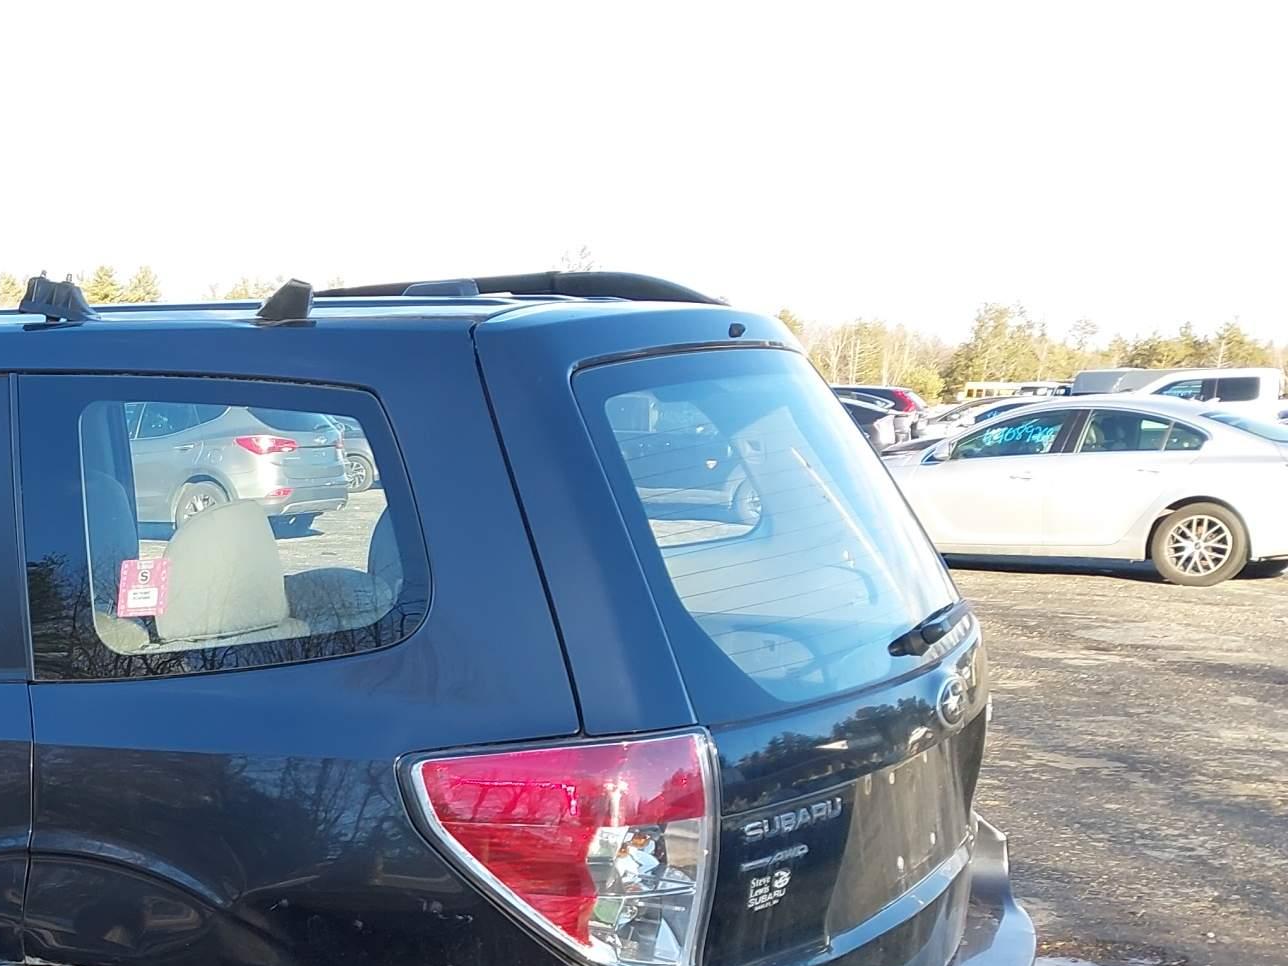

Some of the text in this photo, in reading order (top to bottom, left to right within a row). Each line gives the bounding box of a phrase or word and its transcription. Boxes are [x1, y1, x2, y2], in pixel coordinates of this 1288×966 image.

[140, 570, 149, 582] S
[743, 798, 843, 843] SUBARU
[750, 876, 771, 889] Steve
[747, 888, 787, 908] SUBARU
[749, 884, 771, 899] Lewis
